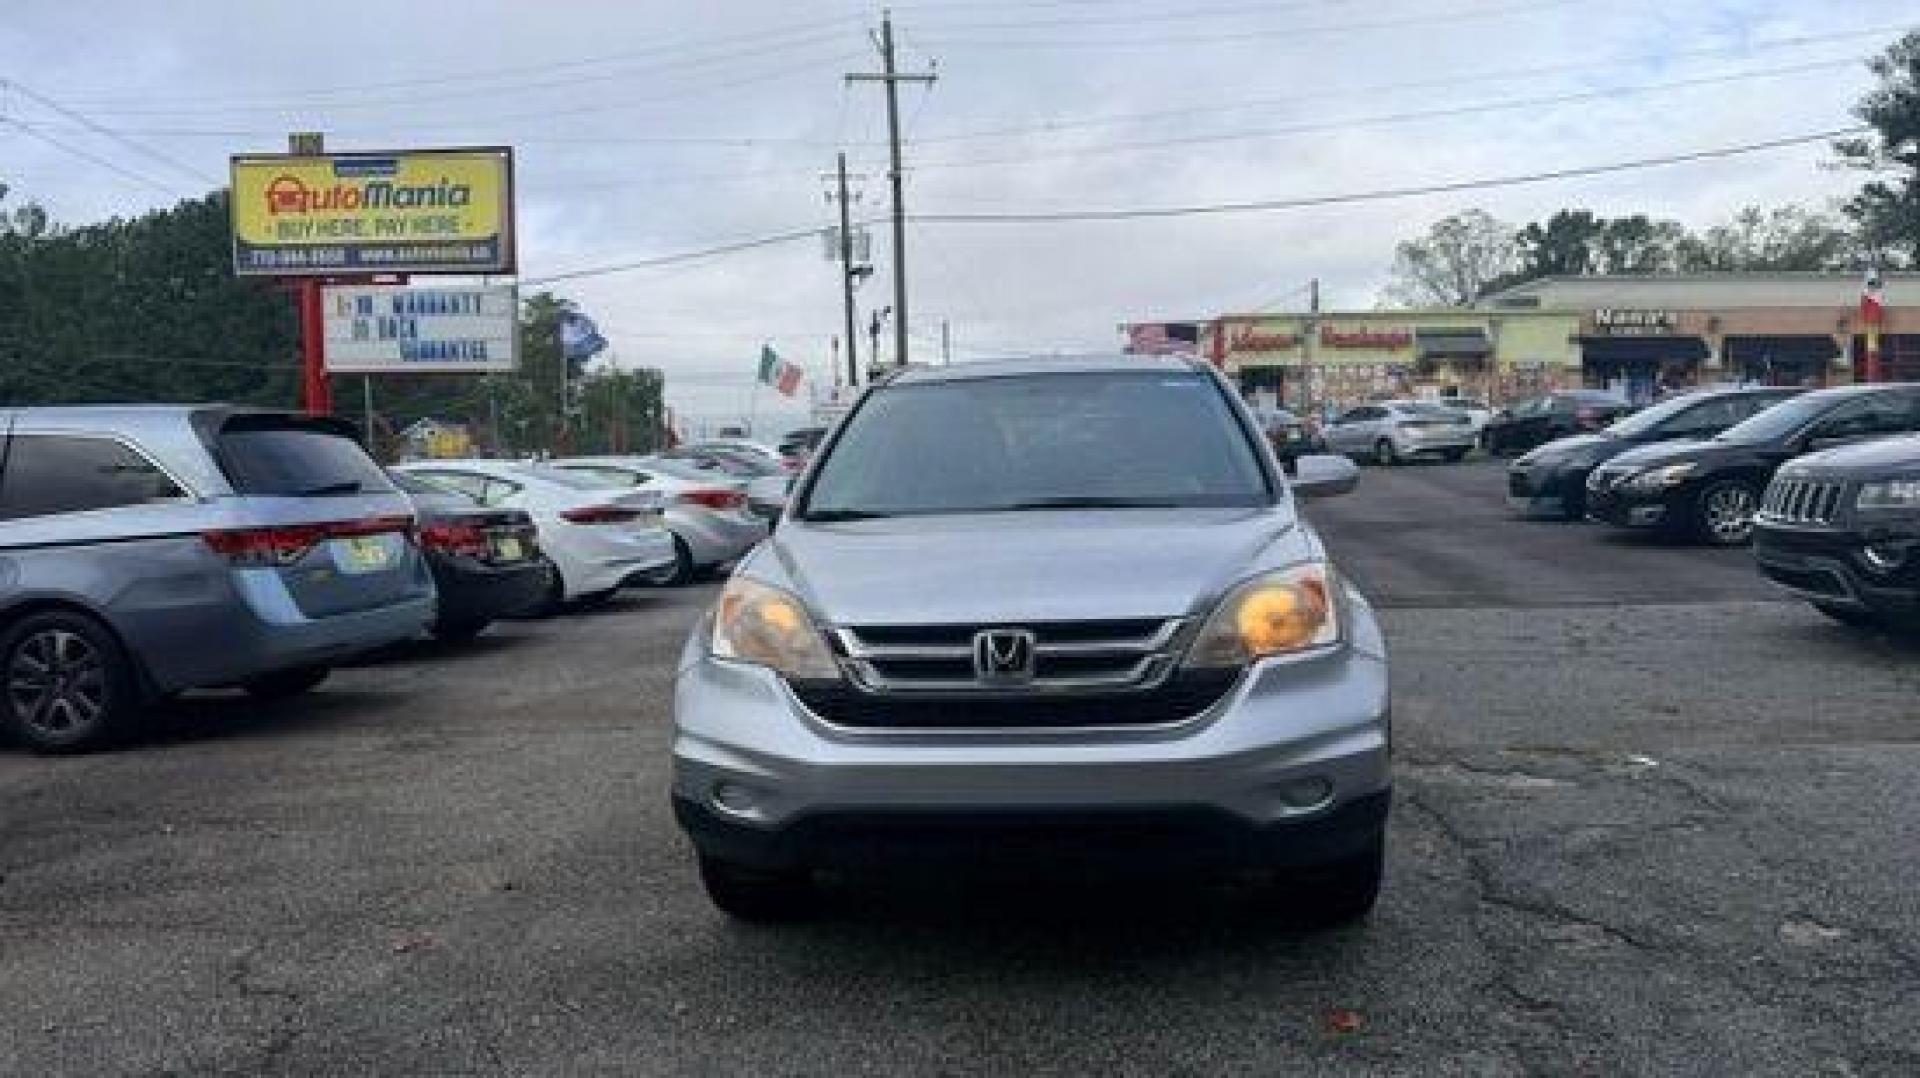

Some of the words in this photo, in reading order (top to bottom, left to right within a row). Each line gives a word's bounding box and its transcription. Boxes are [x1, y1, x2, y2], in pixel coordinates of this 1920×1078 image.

[265, 175, 470, 216] AutoMania
[278, 220, 316, 239] BUY
[374, 217, 404, 237] PAY
[408, 215, 459, 234] HERE
[393, 291, 481, 315] WARRANTY
[401, 339, 488, 363] GUARANTEE
